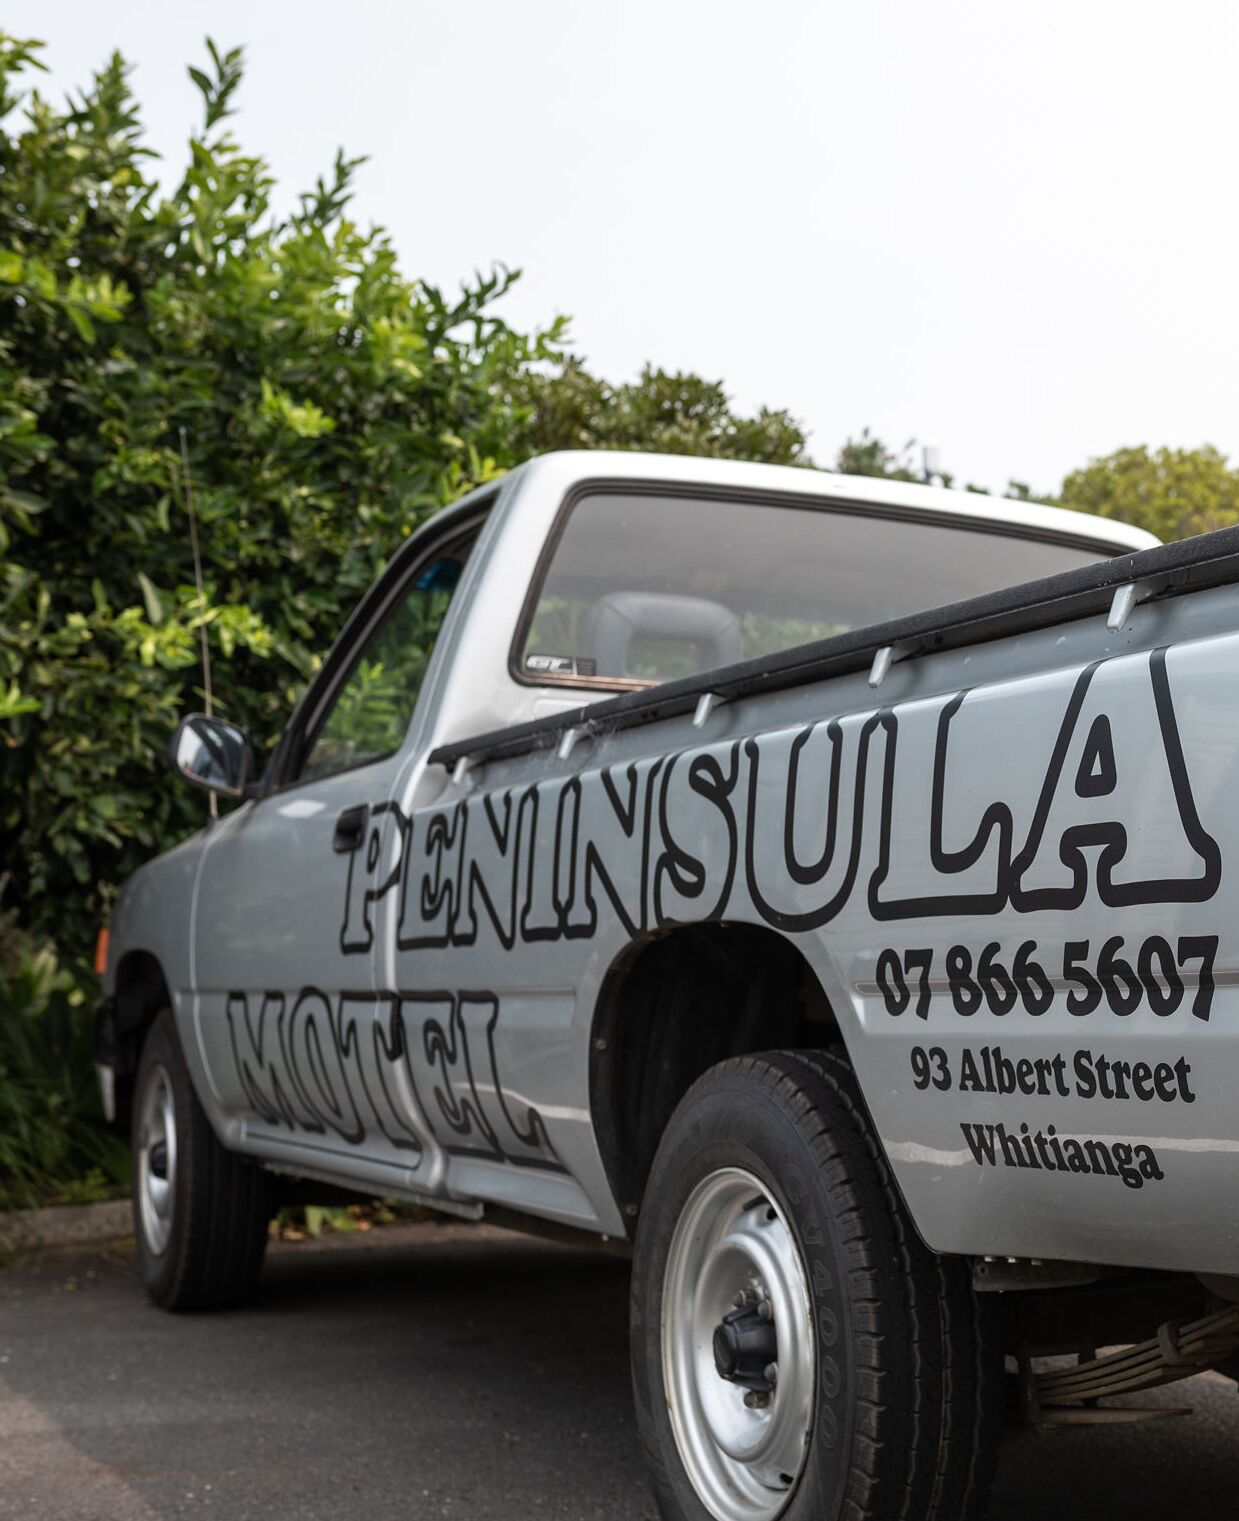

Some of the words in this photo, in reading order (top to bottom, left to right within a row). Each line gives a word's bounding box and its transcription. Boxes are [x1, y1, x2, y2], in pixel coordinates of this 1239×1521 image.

[341, 646, 1222, 955] PENINSULA
[875, 948, 933, 1020] 07
[946, 941, 1055, 1017] 866
[1062, 934, 1219, 1021] 5607
[227, 986, 573, 1174] MOTEL
[910, 1045, 952, 1091] 93
[959, 1046, 1069, 1097] Albert
[1073, 1050, 1195, 1103] Street
[960, 1123, 1164, 1189] Whitianga
